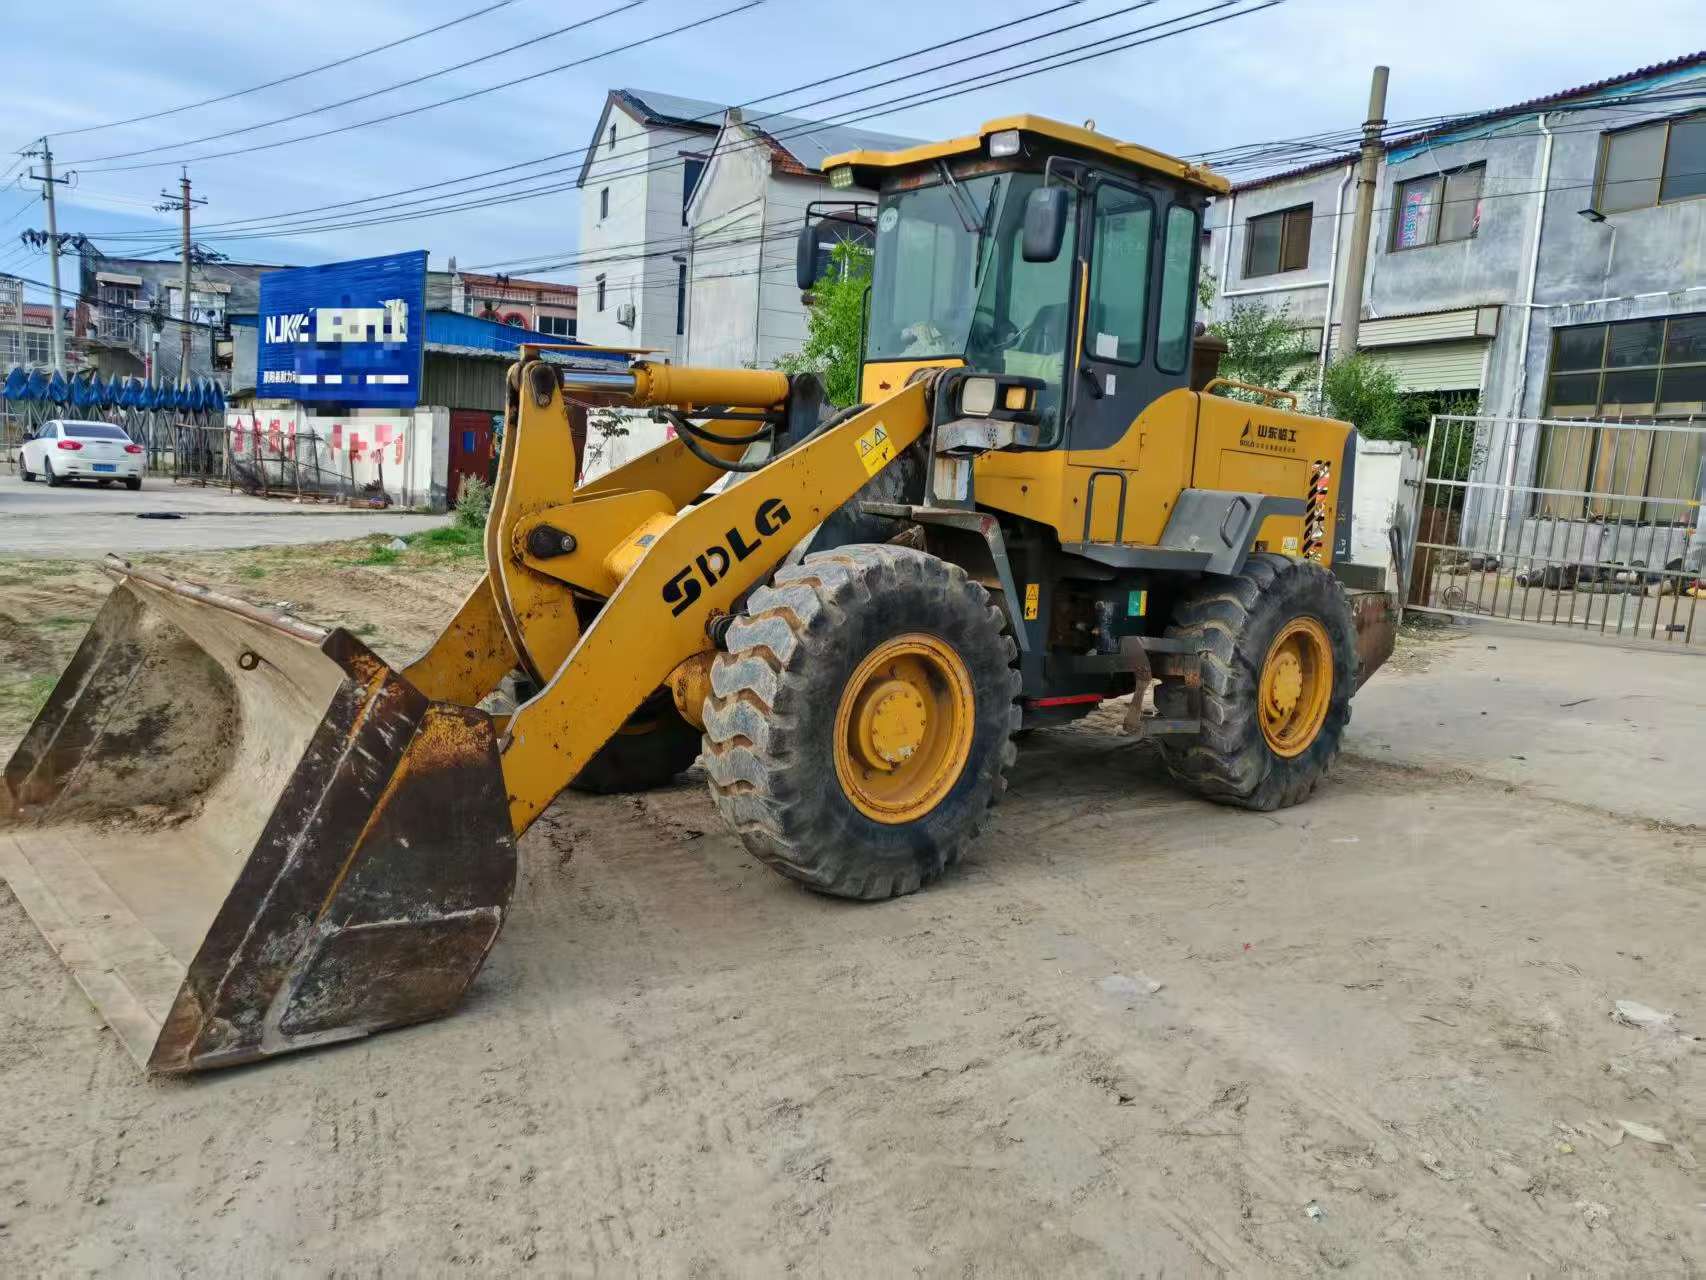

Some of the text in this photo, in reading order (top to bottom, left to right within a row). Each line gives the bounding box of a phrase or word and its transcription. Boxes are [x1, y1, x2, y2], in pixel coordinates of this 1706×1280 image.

[1257, 424, 1297, 443] 山东临工
[662, 498, 792, 617] SDLG
